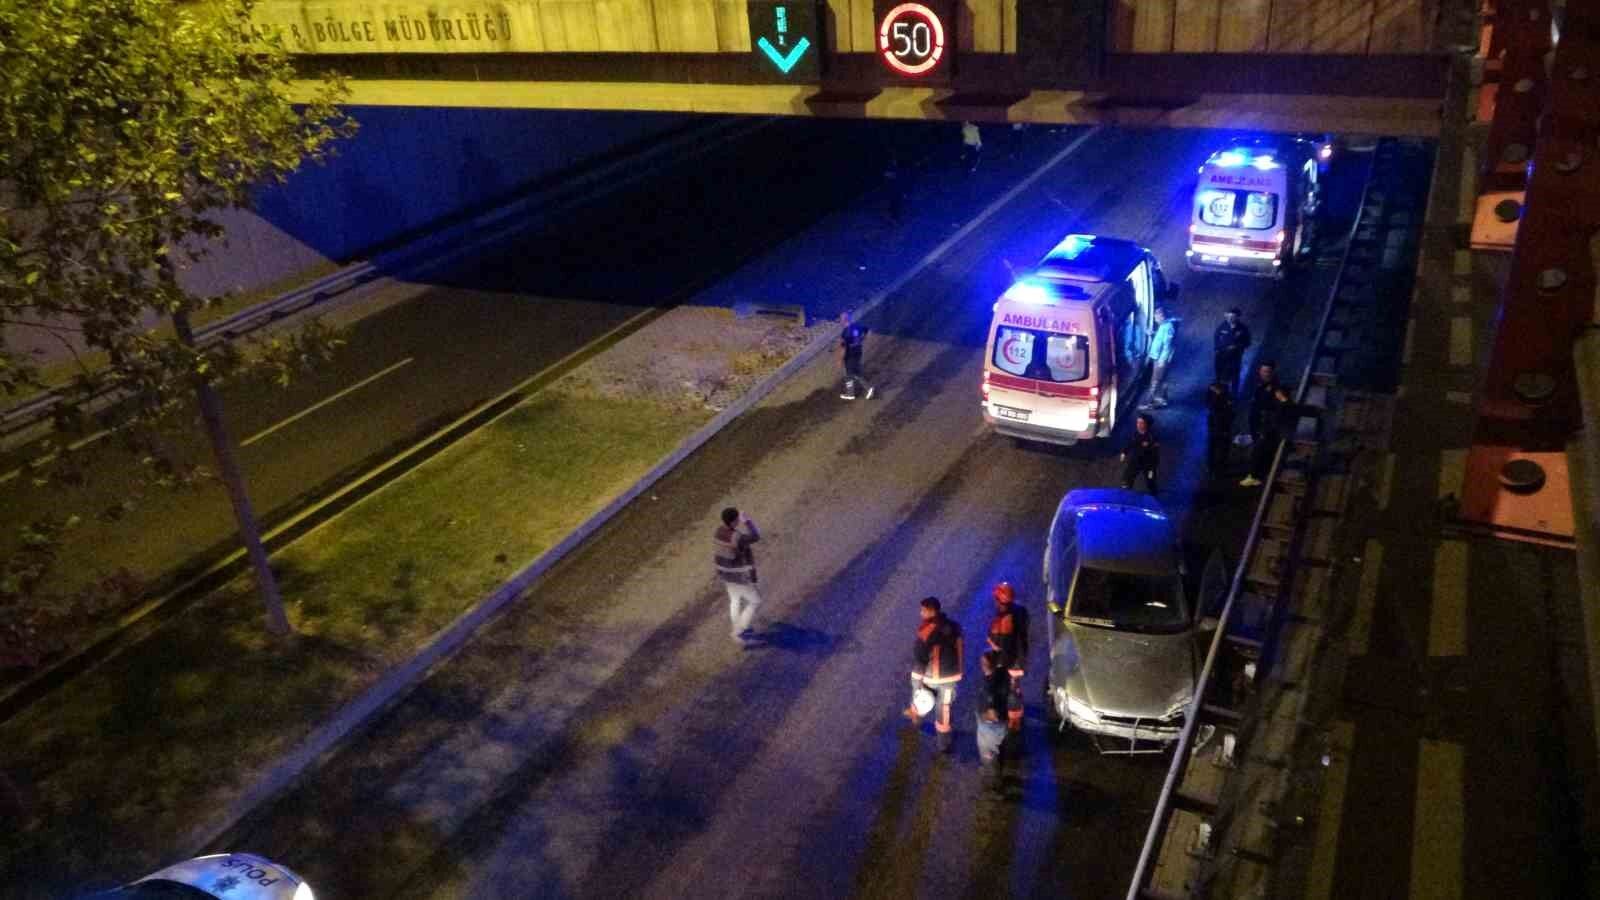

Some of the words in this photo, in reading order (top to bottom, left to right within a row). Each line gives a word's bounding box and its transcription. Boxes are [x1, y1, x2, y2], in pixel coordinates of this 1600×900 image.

[314, 17, 375, 42] BÖLGE
[384, 12, 512, 41] MÜDÜRLÜĞÜ
[893, 22, 931, 57] 50
[1003, 313, 1081, 332] AMBULANS
